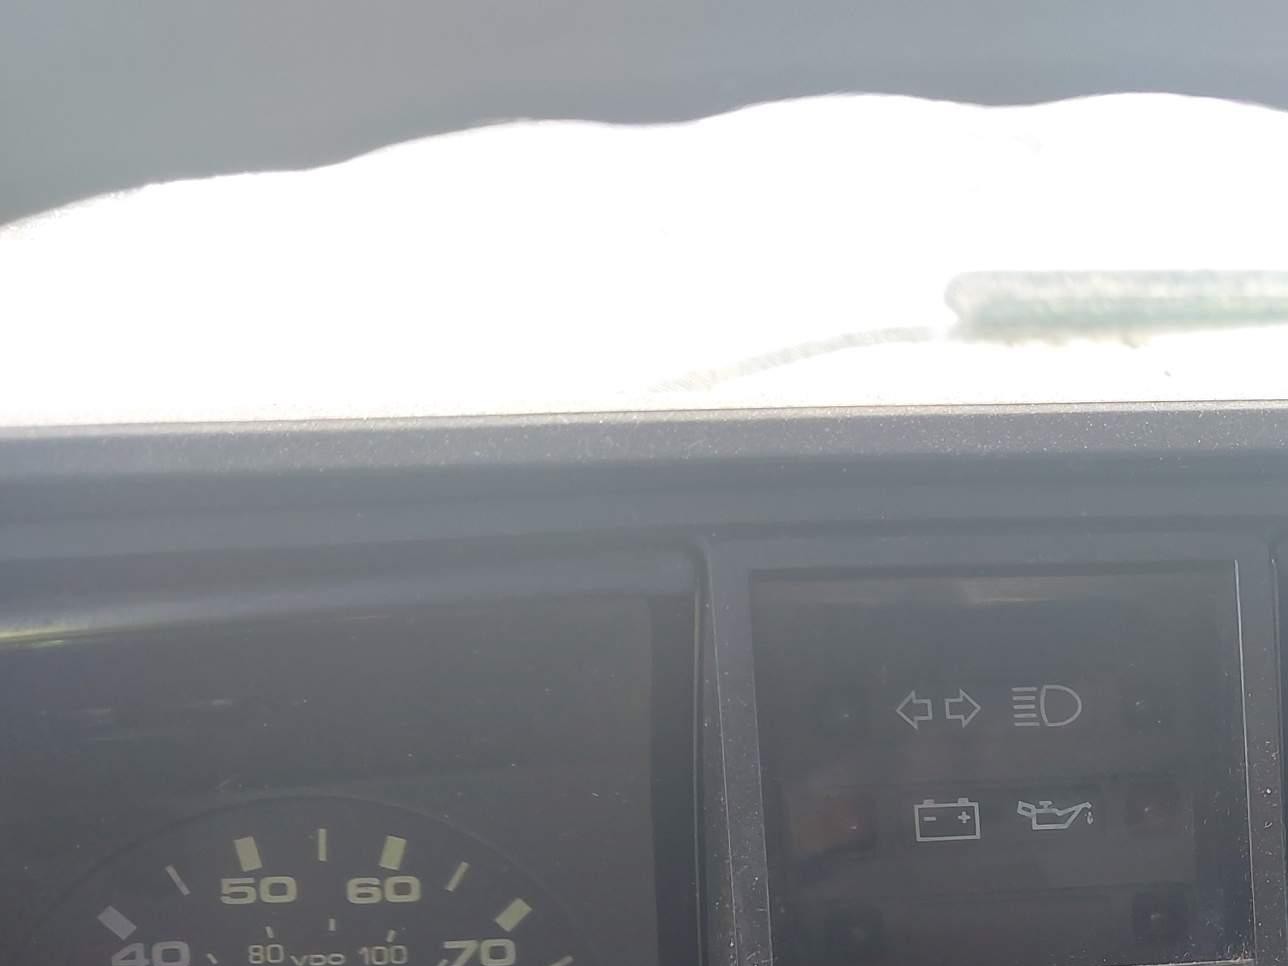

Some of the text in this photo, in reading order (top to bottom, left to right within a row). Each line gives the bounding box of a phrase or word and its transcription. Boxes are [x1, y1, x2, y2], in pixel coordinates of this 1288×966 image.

[220, 876, 297, 904] 50
[347, 876, 421, 904] 60
[249, 945, 284, 964] 80
[290, 953, 346, 966] VDO
[358, 946, 408, 966] 100
